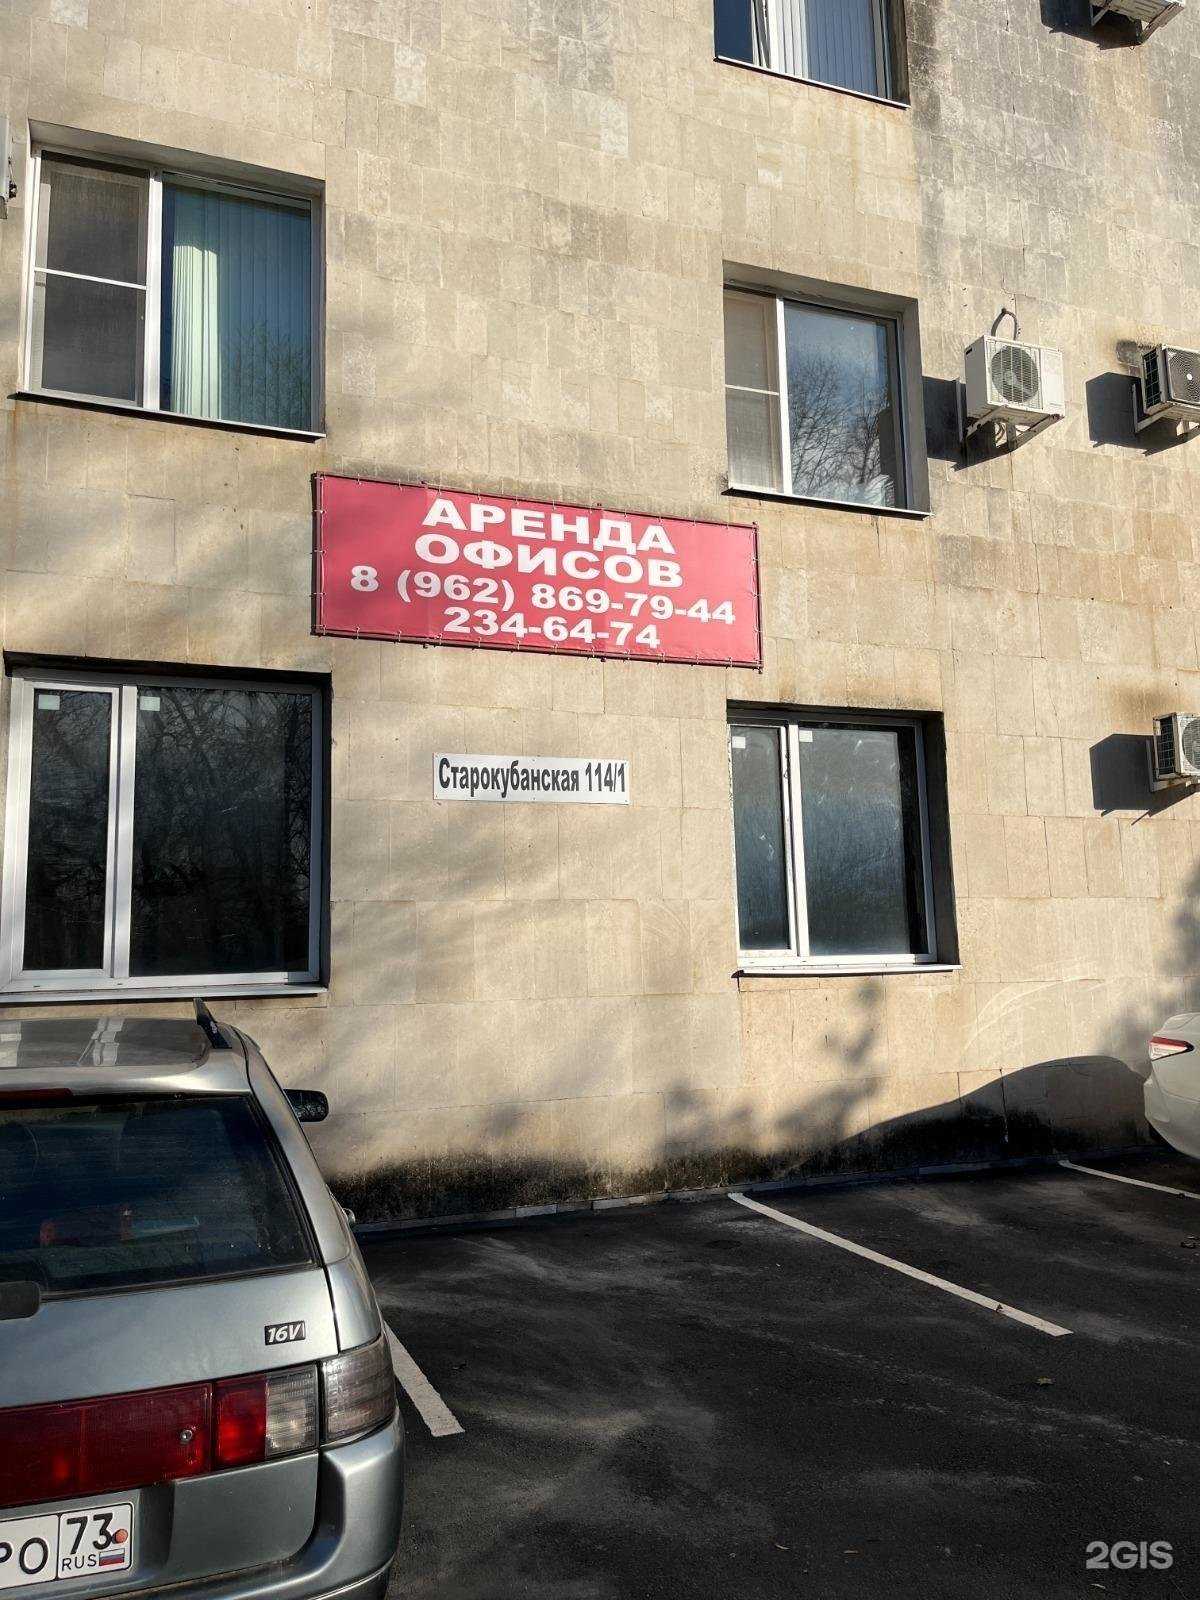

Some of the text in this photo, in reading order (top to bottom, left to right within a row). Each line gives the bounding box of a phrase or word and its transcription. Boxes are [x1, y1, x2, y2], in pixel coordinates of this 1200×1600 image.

[422, 499, 675, 555] АРЕНДА
[414, 533, 684, 588] ОФИСОВ
[350, 565, 736, 625] 8 (962) 869-79-44
[443, 606, 661, 649] 234-64-74
[438, 757, 626, 798] Старокубанская 114/1
[268, 1323, 302, 1343] 16V
[66, 1512, 114, 1555] 73
[61, 1553, 97, 1571] RUS
